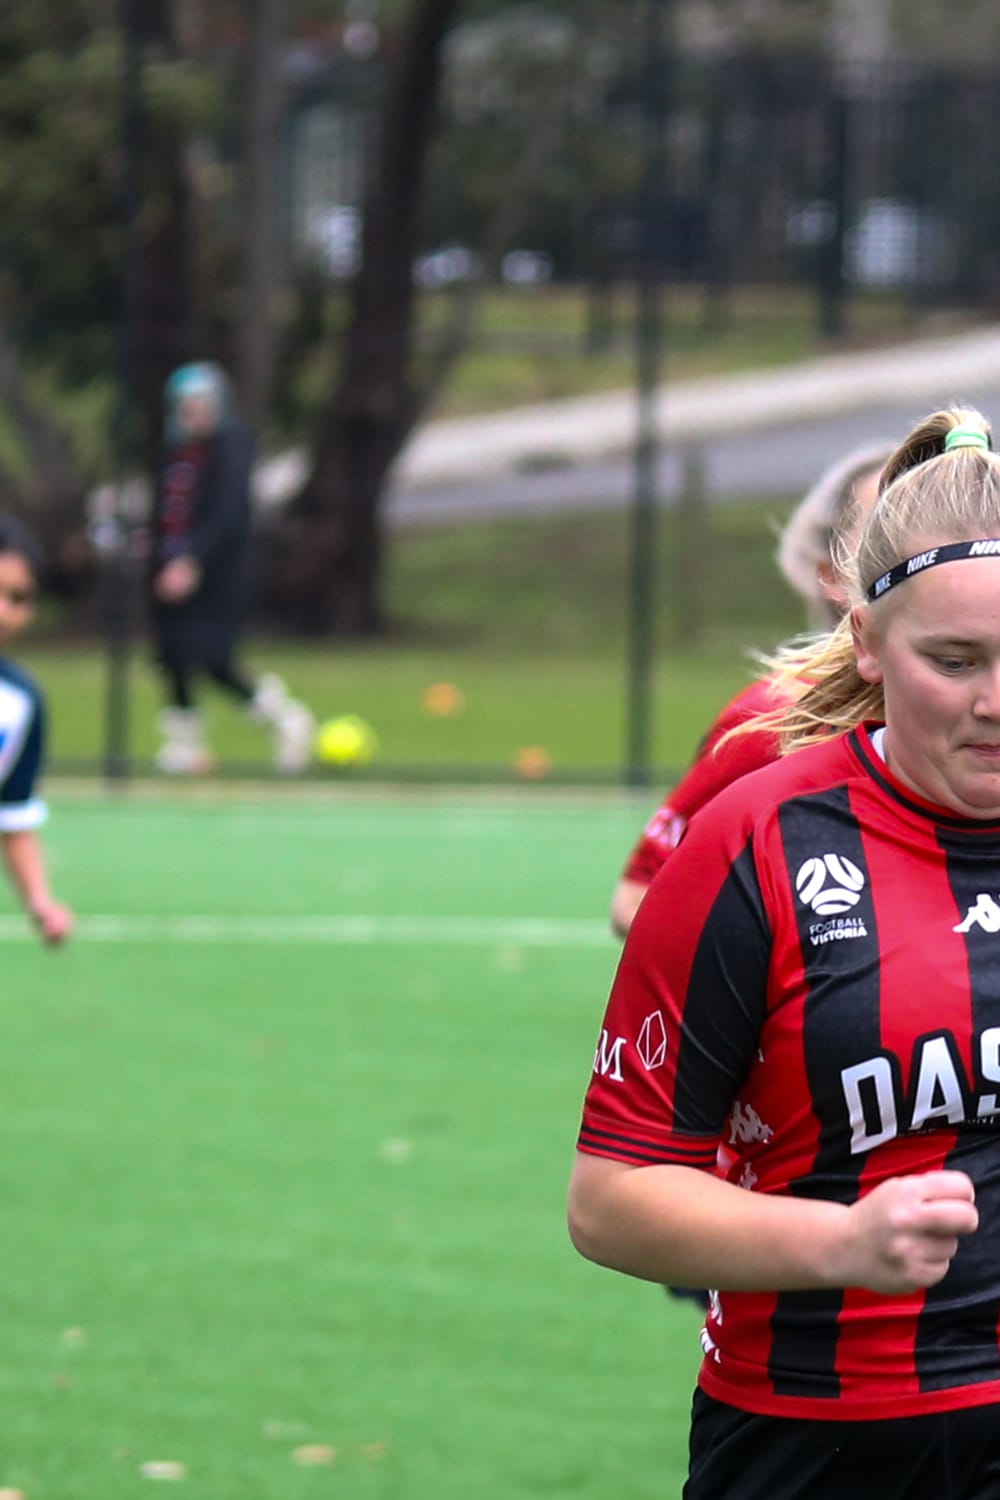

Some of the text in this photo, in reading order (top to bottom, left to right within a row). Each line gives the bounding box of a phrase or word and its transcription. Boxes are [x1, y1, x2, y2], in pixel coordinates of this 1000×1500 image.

[906, 550, 939, 574] NIKE
[875, 573, 891, 596] NIKE
[809, 917, 864, 935] FOOTBALL
[810, 926, 868, 946] VICTORIA
